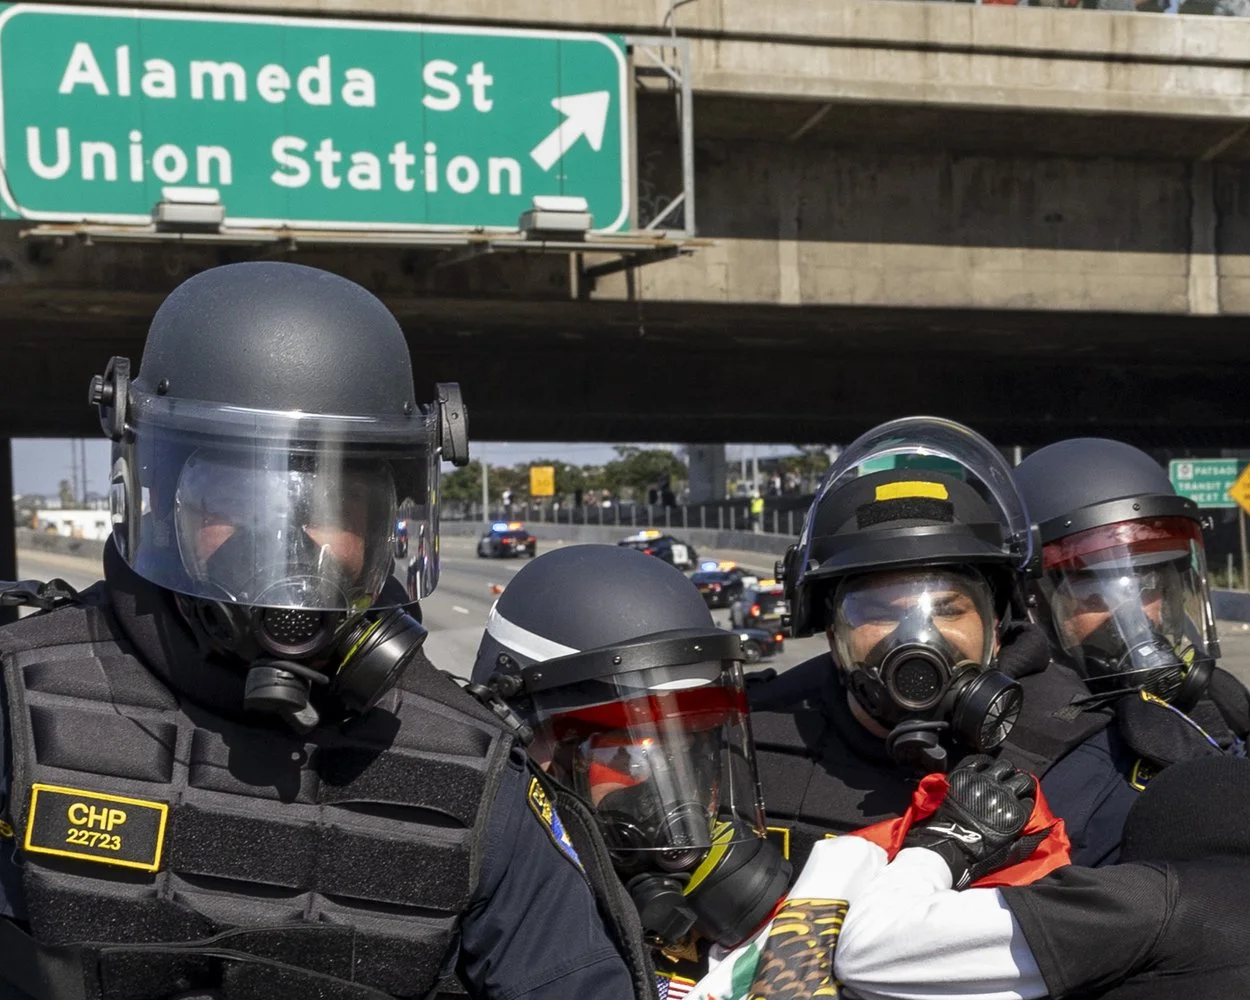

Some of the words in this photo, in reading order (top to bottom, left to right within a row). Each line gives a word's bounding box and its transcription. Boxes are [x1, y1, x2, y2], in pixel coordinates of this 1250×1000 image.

[59, 42, 377, 108] Alameda
[421, 60, 494, 113] St
[25, 126, 232, 185] Union
[271, 135, 523, 196] Station
[1178, 481, 1221, 491] TRANSIT
[67, 802, 127, 832] CHP
[65, 828, 122, 851] 22723
